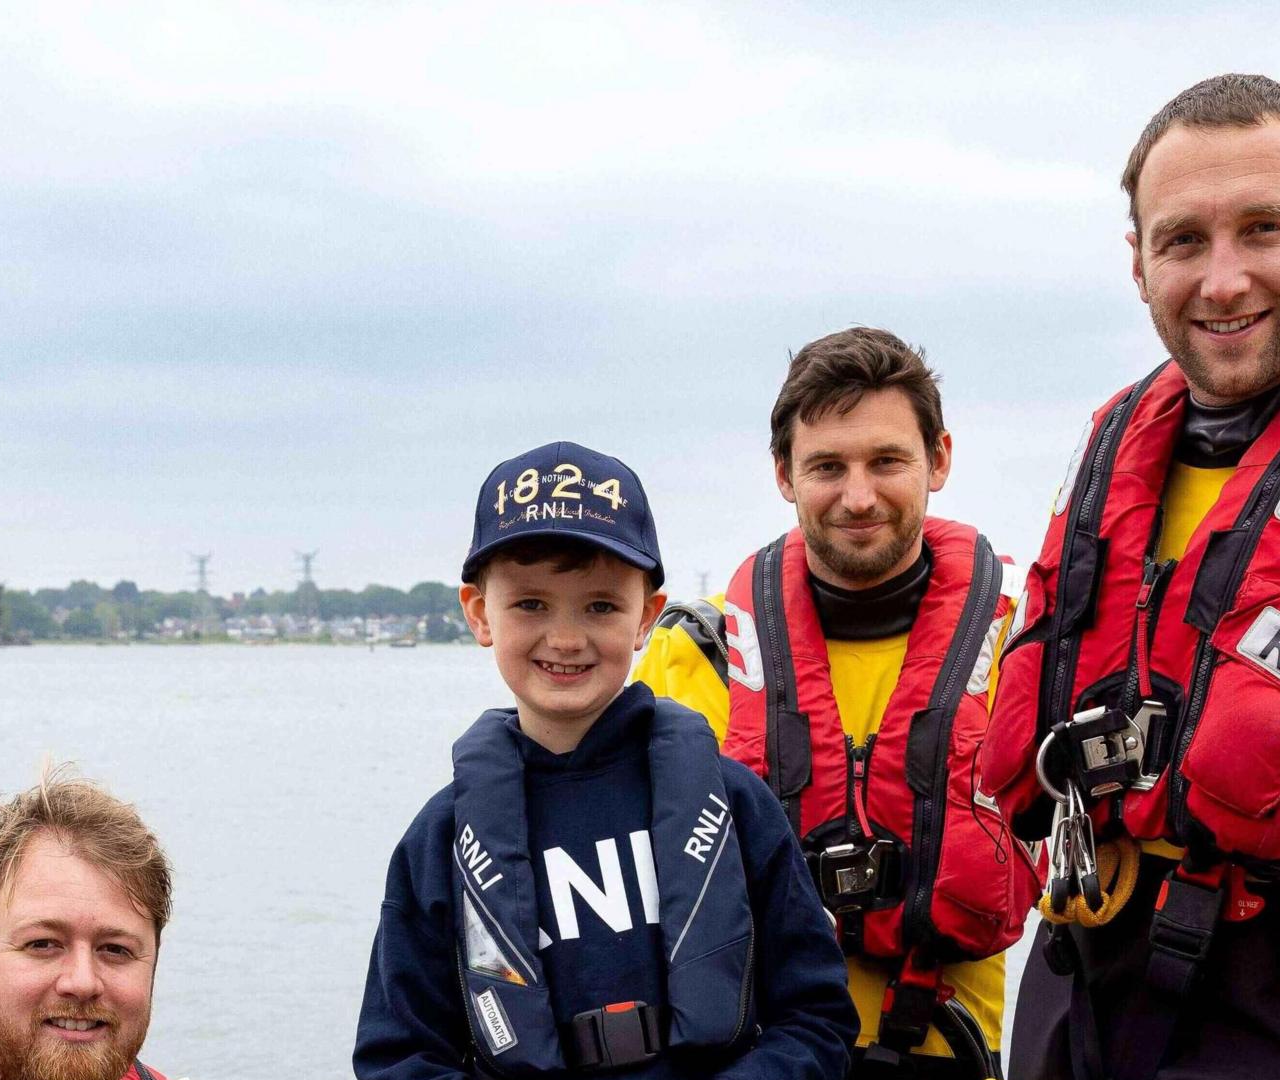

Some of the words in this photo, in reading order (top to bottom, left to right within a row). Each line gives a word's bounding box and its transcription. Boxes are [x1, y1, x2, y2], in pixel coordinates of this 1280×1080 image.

[497, 463, 620, 515] 1824
[526, 501, 583, 522] RNLI
[684, 793, 728, 863] RNLI
[459, 823, 504, 891] RNLI
[481, 995, 509, 1045] AUTOMATIC
